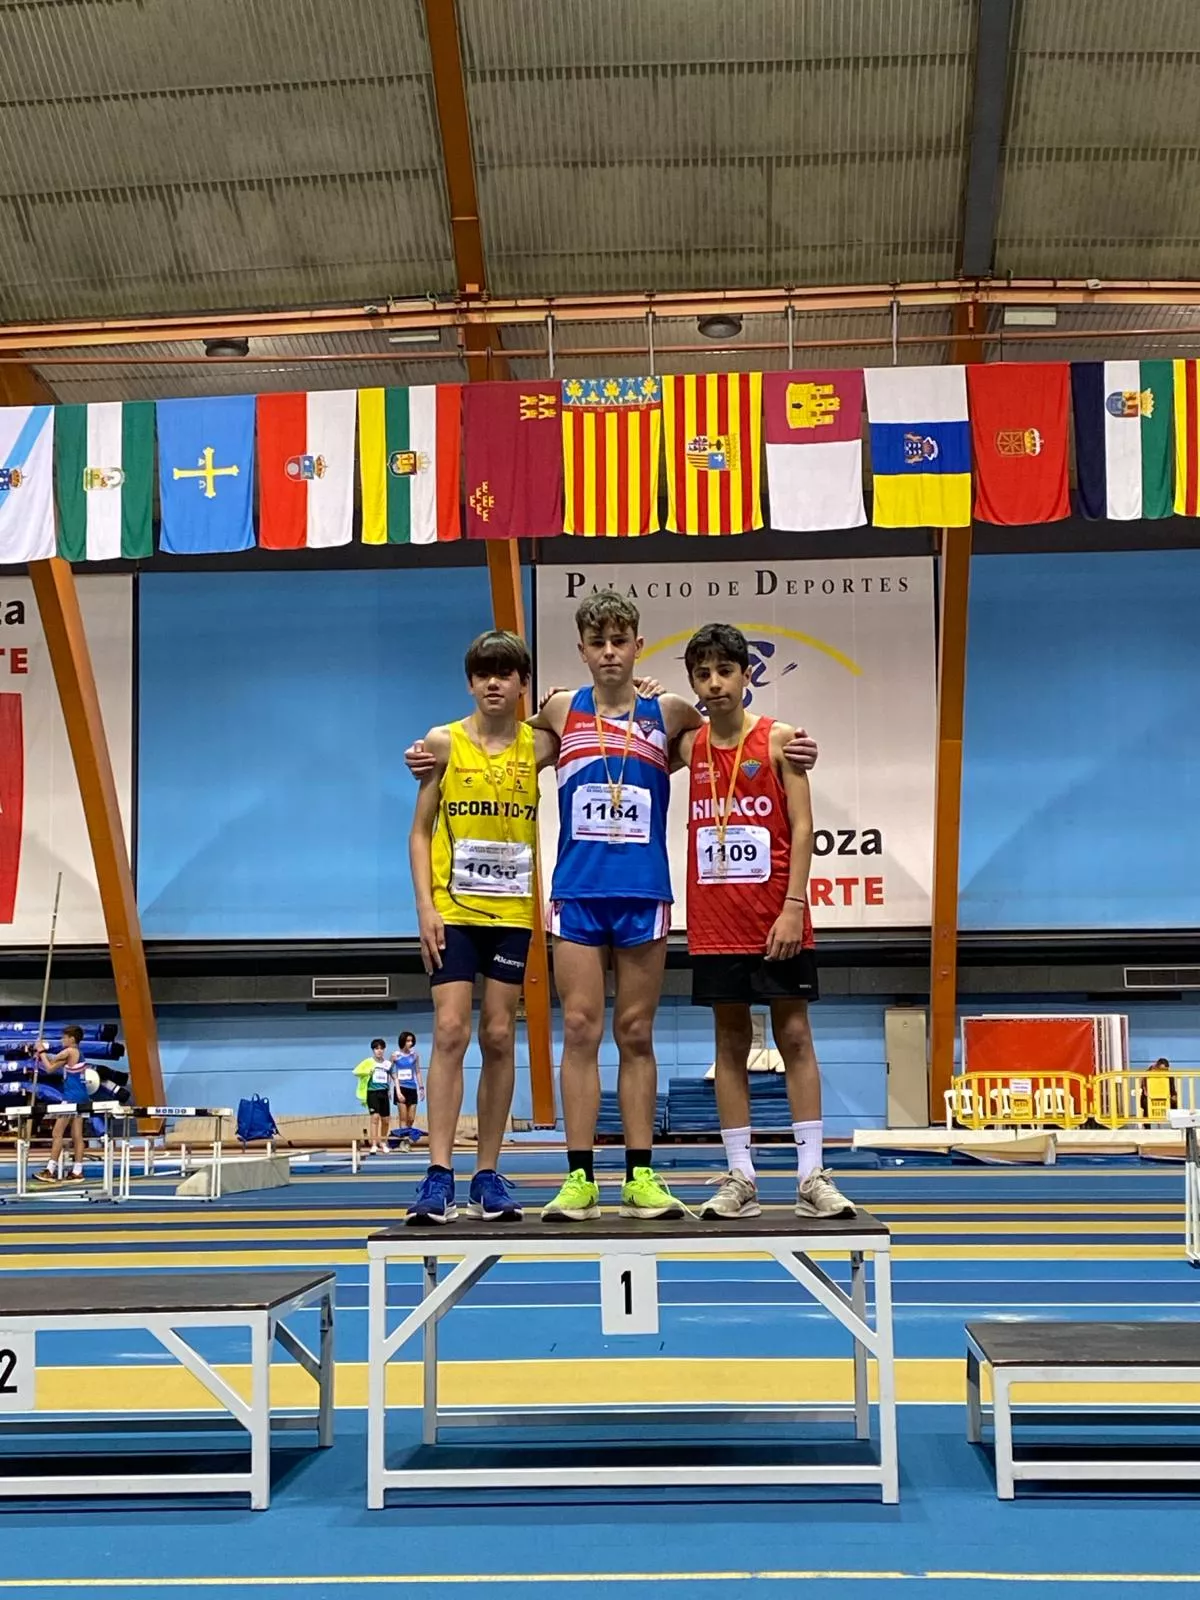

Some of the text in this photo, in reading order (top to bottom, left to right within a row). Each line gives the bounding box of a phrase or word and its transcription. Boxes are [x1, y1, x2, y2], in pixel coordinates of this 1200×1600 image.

[708, 581, 740, 597] DE
[755, 569, 909, 596] DEPORTES
[0, 600, 25, 625] a
[582, 802, 639, 822] 1164
[705, 844, 757, 863] 1109
[620, 1270, 633, 1315] 1
[0, 1348, 18, 1394] 2
